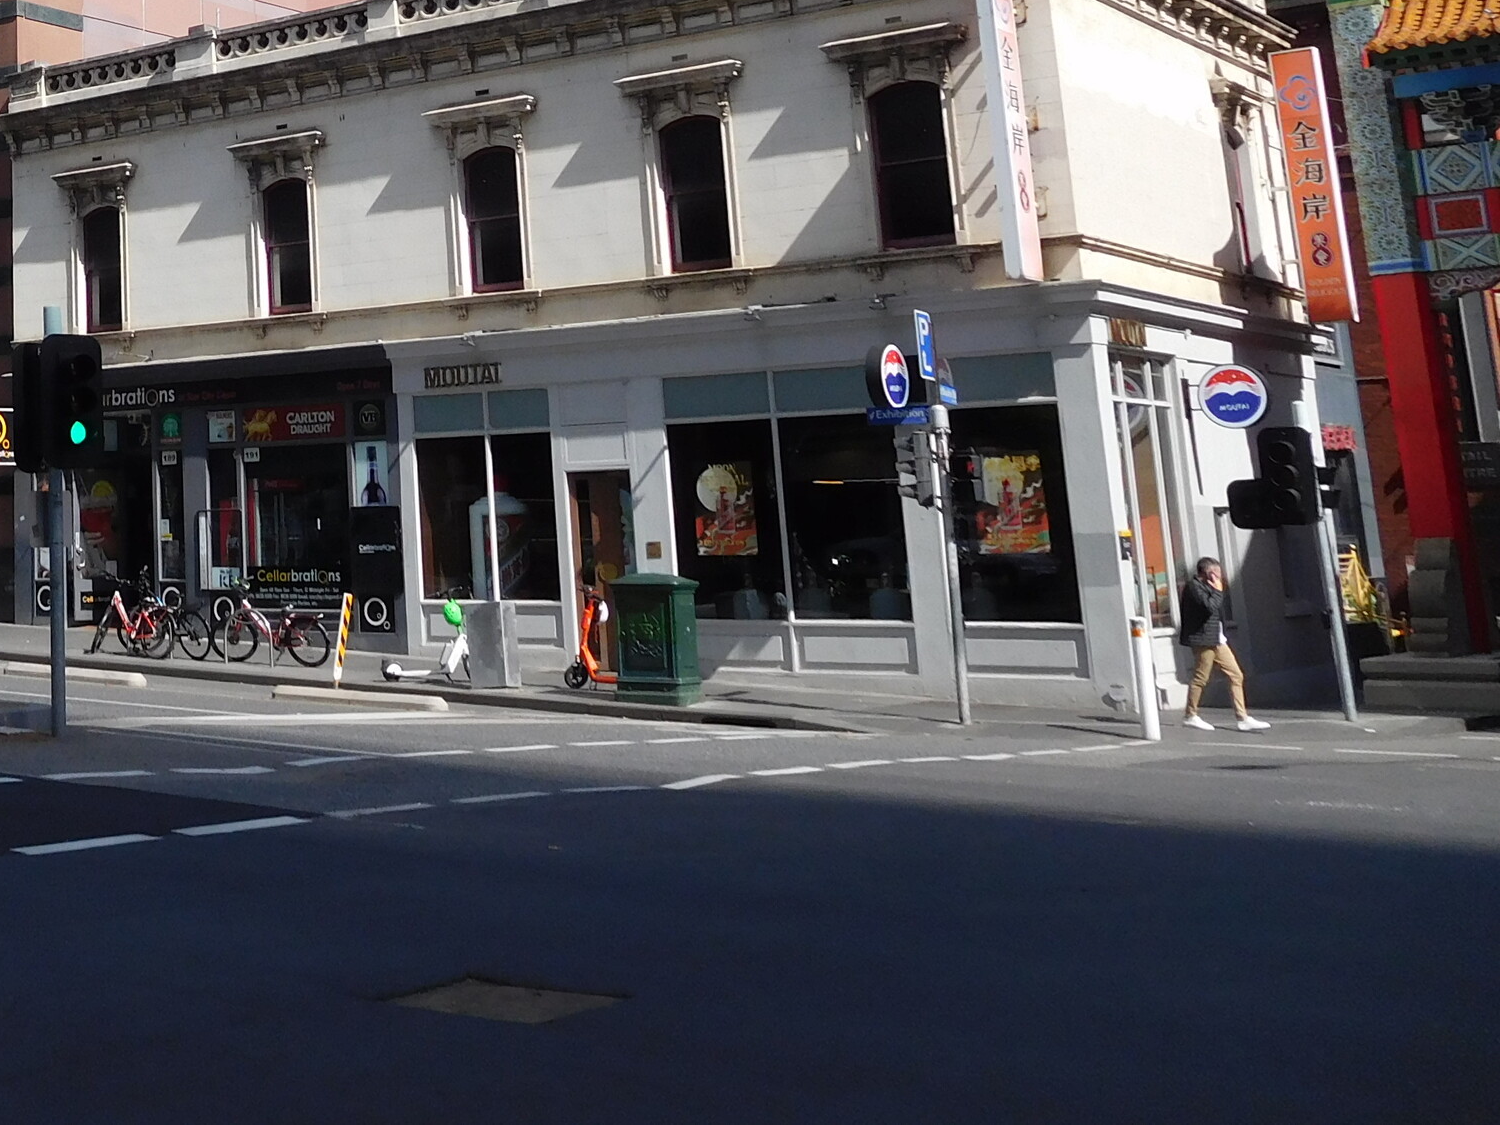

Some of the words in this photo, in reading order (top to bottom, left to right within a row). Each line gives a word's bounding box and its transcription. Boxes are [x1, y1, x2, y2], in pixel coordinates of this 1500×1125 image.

[1290, 121, 1331, 223] 金海岸
[424, 362, 501, 388] MOUTAI
[1219, 403, 1250, 412] MOUTAI
[286, 411, 334, 424] CARLTON
[876, 409, 925, 420] Exhibition
[290, 424, 331, 435] DRAUGHT
[257, 568, 341, 584] Cellarbrations
